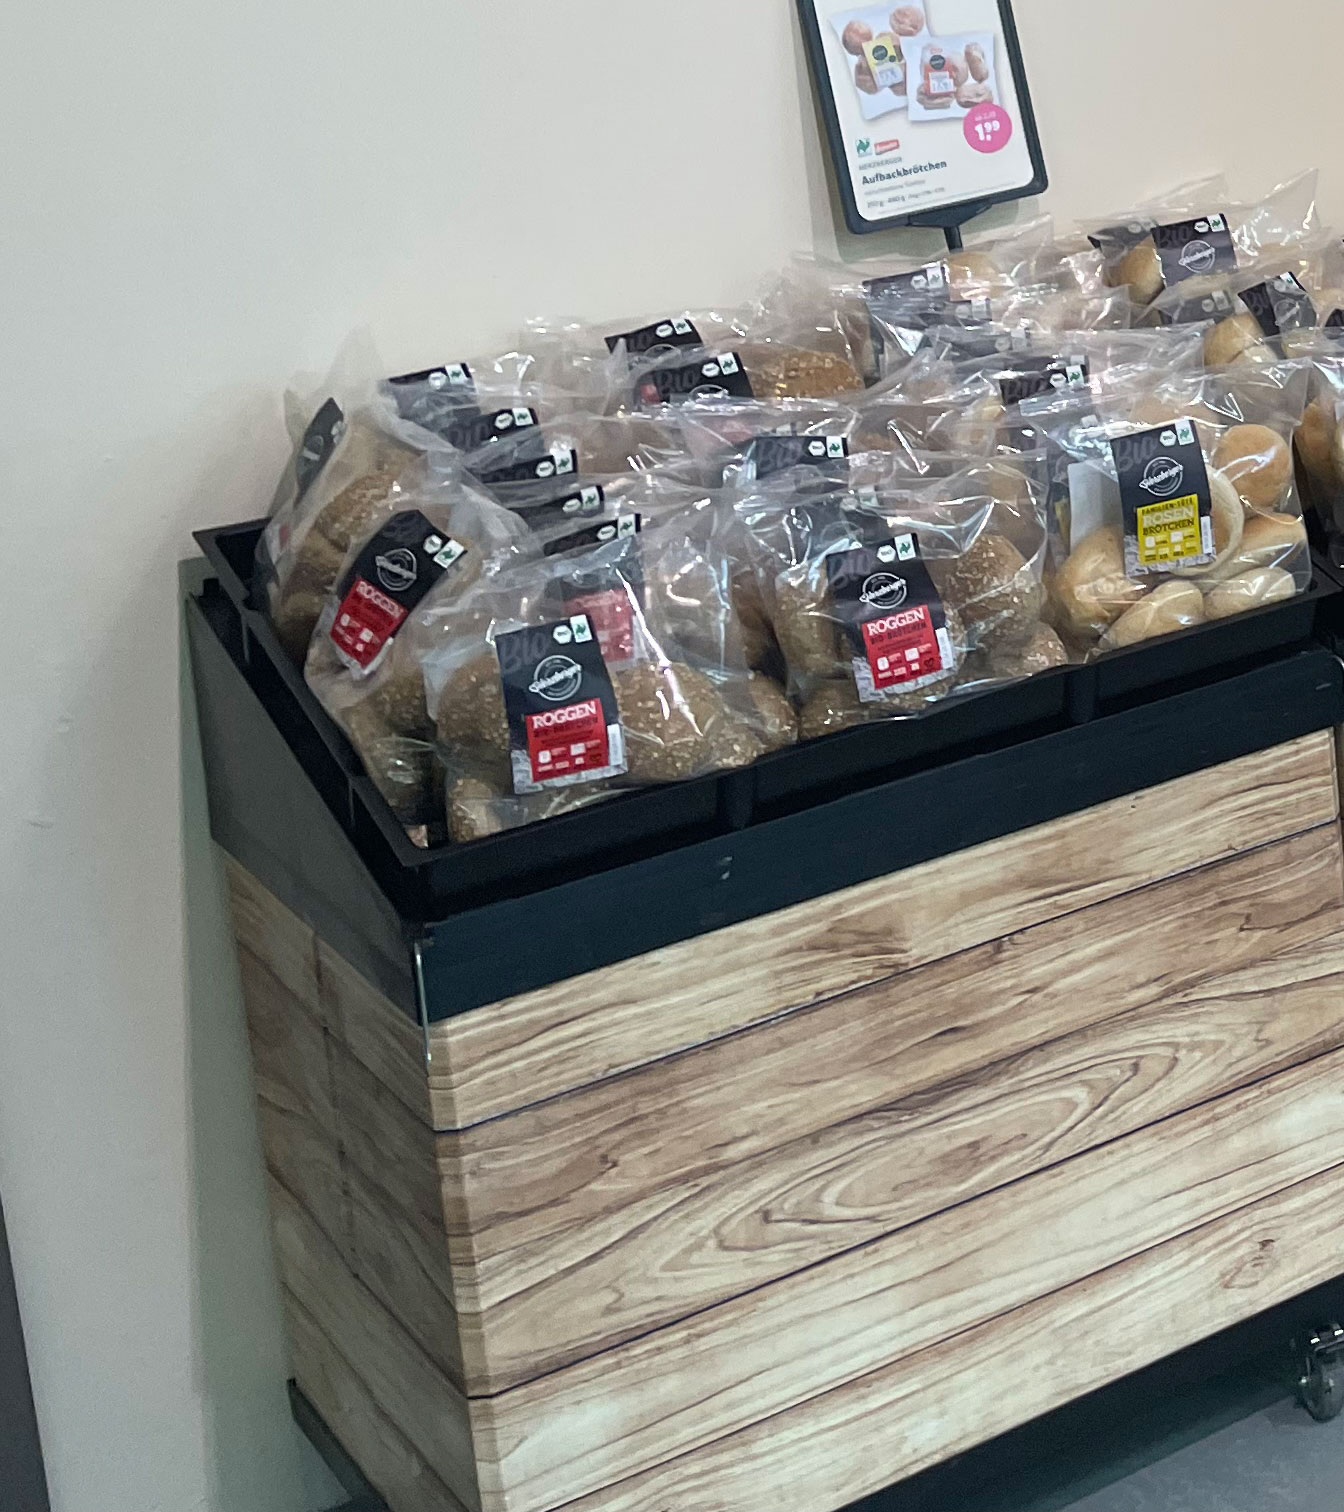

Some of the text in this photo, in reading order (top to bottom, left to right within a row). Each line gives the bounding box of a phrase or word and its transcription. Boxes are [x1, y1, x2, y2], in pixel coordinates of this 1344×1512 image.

[862, 160, 948, 186] Aufbackbrötchen
[1142, 504, 1194, 527] ROSEN
[1142, 518, 1195, 536] BRÖTCHEN
[867, 608, 925, 637] ROGGEN
[532, 700, 597, 729] ROGGEN
